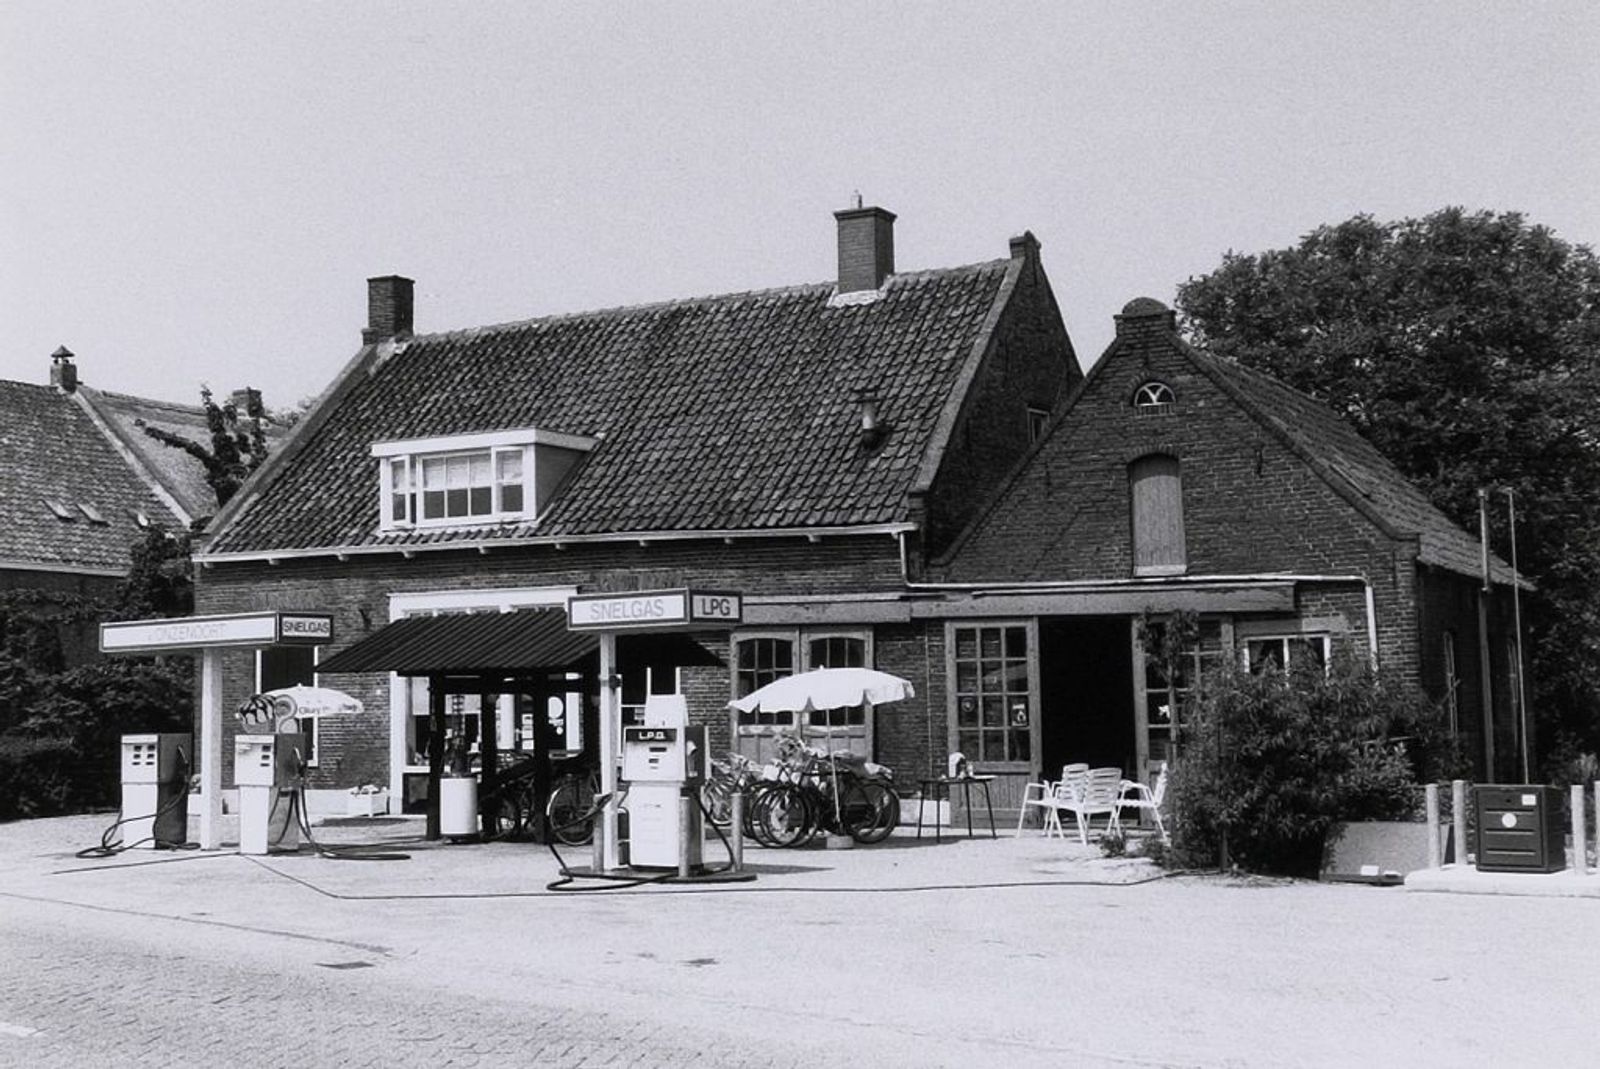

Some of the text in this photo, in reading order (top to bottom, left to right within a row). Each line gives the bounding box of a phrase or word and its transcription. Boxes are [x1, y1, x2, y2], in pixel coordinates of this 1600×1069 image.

[590, 598, 664, 620] SNELGAS
[702, 598, 731, 616] LPG
[283, 620, 330, 633] SNELGAS
